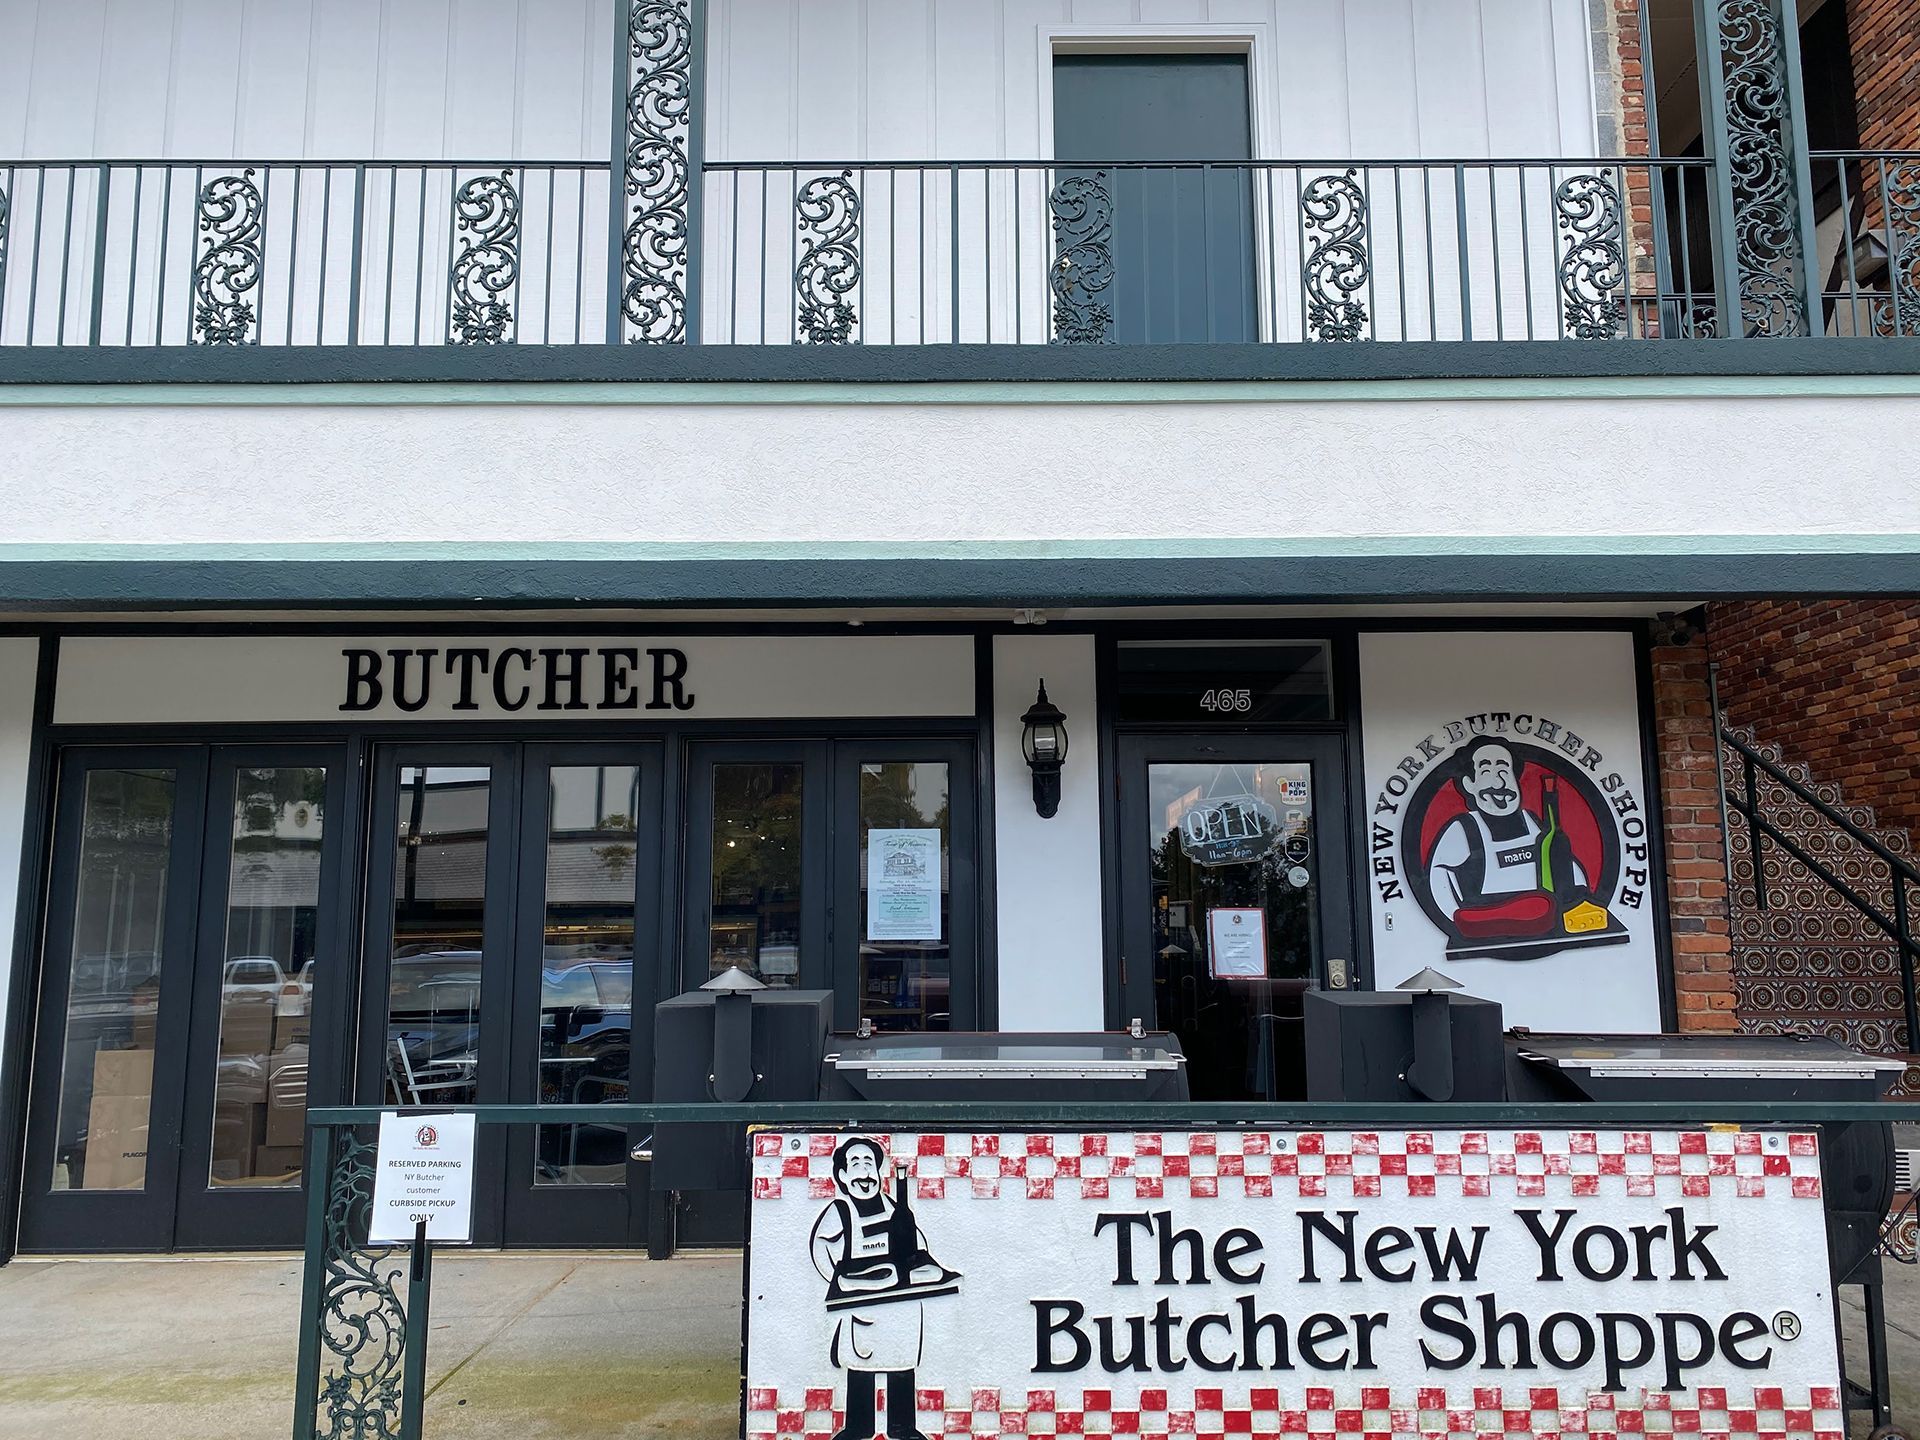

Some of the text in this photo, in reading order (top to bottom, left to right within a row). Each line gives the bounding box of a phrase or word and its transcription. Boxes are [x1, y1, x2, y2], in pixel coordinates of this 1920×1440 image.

[339, 647, 695, 712] BUTCHER
[1200, 688, 1252, 712] 465
[1372, 711, 1647, 910] NEW YORK BUTCHER SHOPPE
[1187, 803, 1264, 843] OPEN
[1504, 849, 1533, 863] mario
[388, 1160, 462, 1168] RESERVED PARKING
[416, 1173, 445, 1181] Butcher
[389, 1199, 456, 1207] CURBSIDE PICKUP
[409, 1213, 435, 1222] ONLY
[862, 1241, 886, 1250] mario
[1093, 1206, 1729, 1285] The New York
[1030, 1294, 1389, 1373] Butcher
